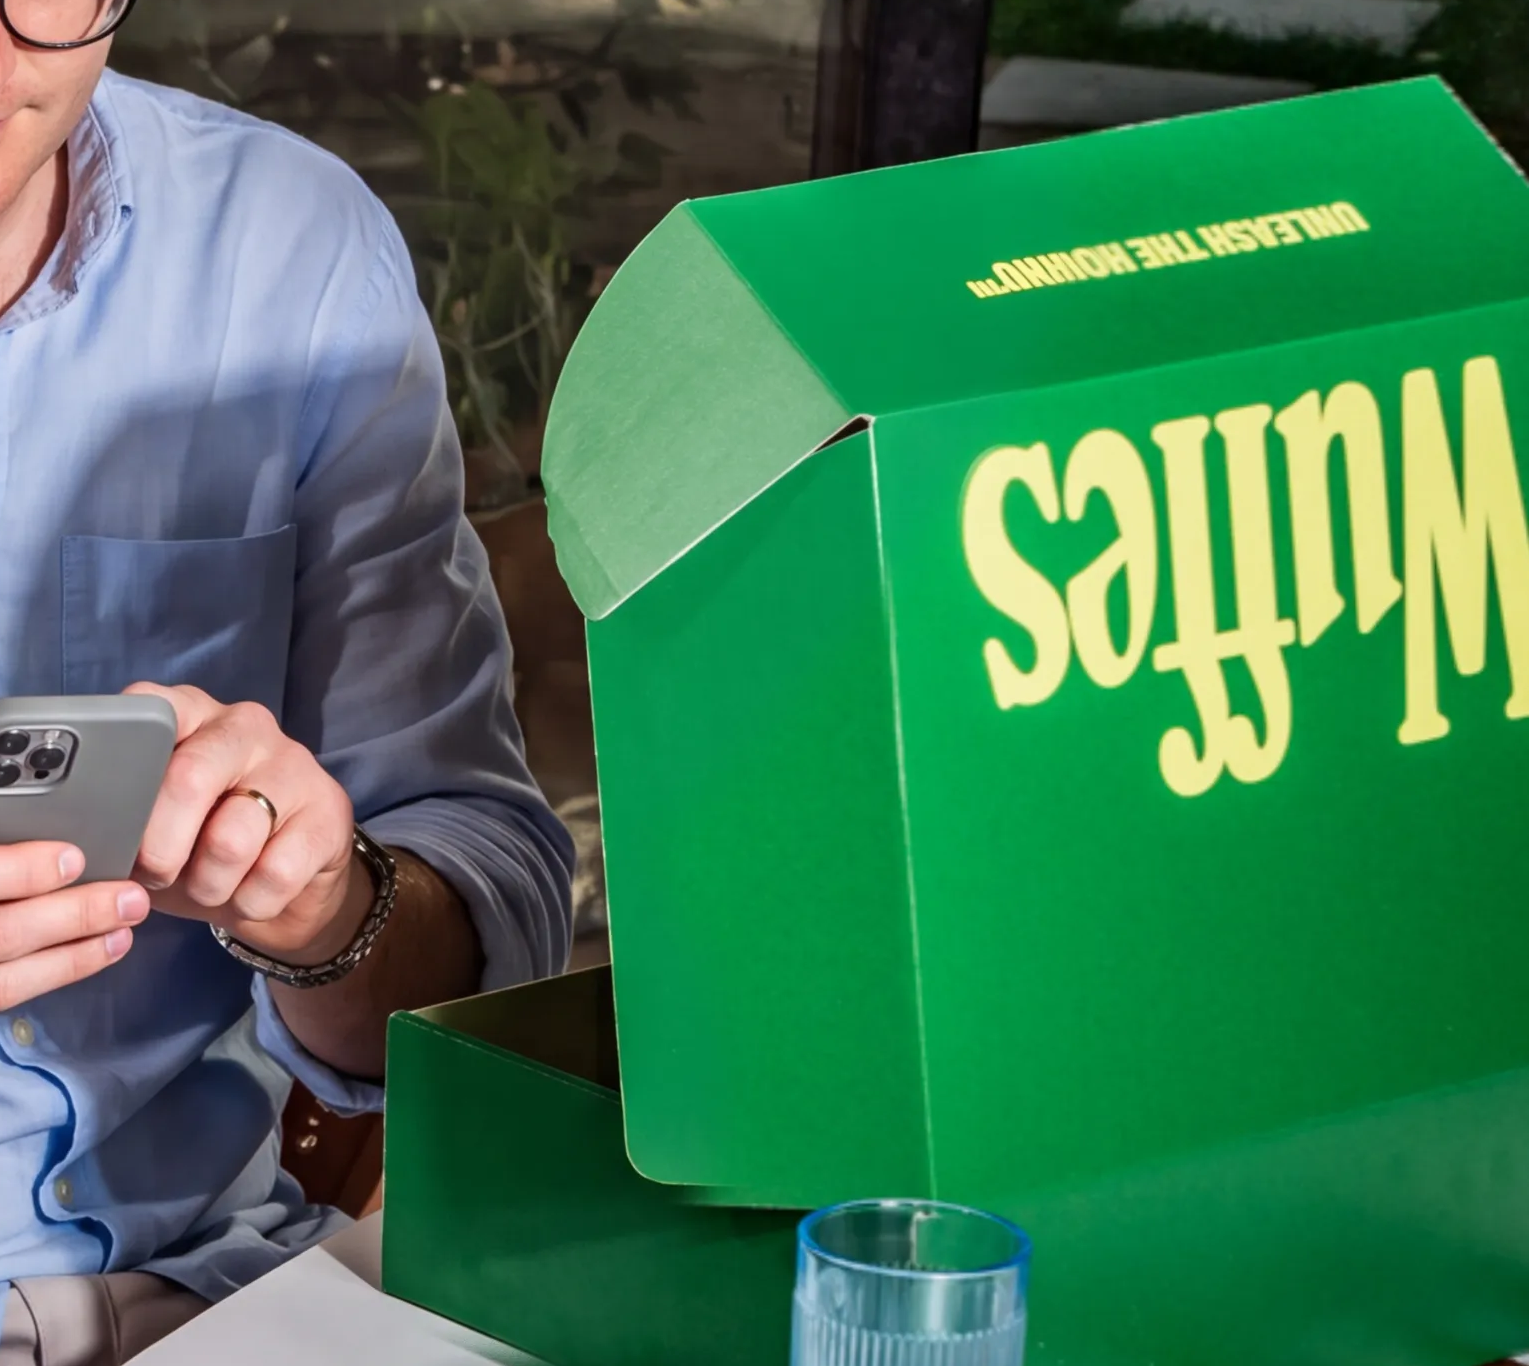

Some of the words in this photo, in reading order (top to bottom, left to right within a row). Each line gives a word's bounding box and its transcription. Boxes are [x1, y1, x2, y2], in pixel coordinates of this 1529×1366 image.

[1125, 229, 1211, 270] THE
[1196, 201, 1371, 257] UNLEASH
[960, 355, 1529, 797] Wuffes
